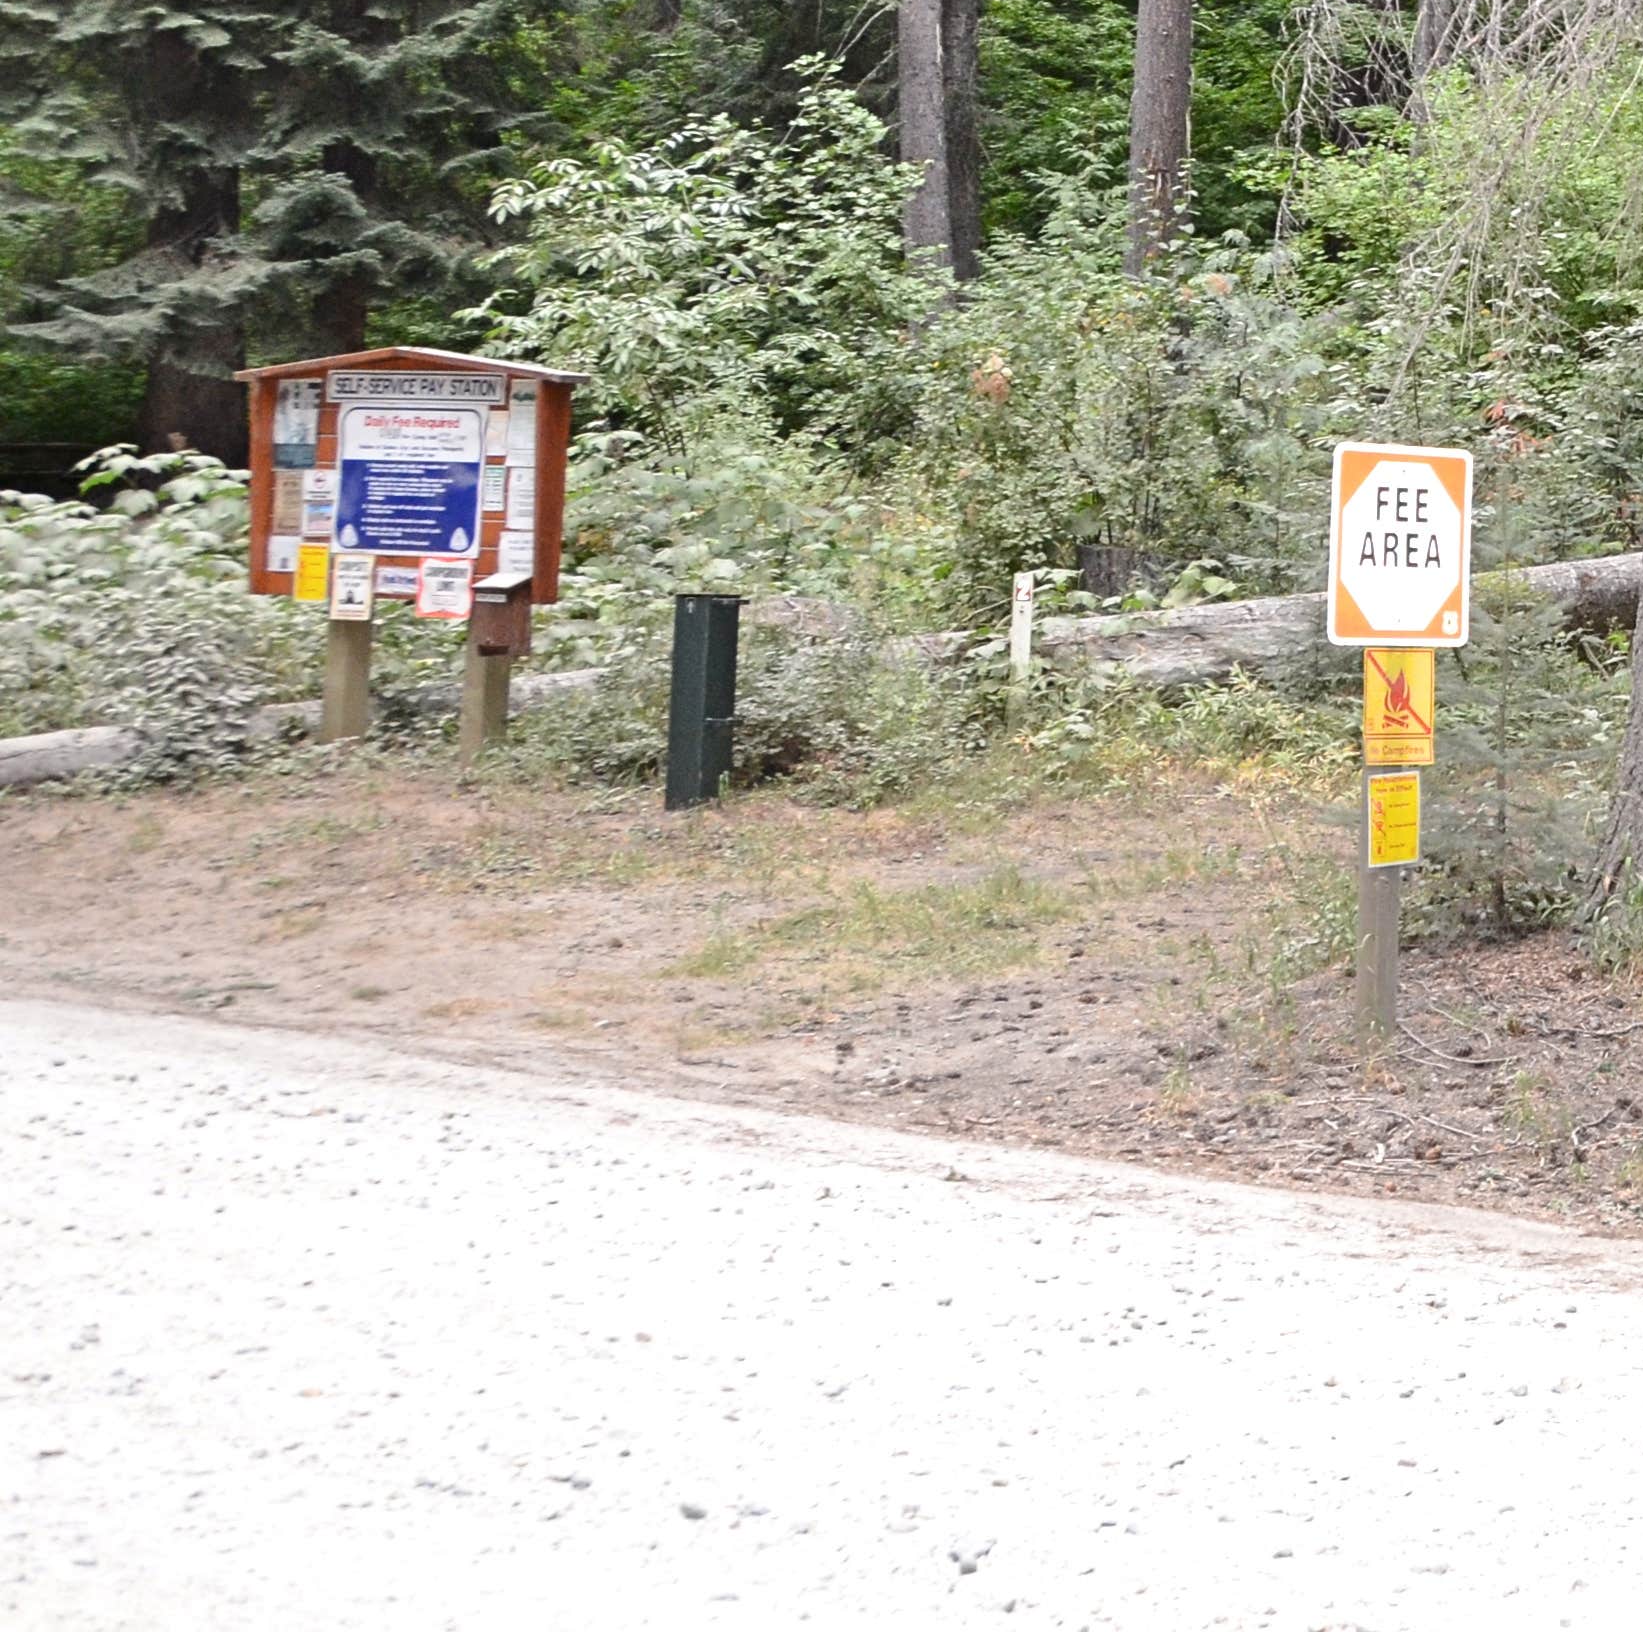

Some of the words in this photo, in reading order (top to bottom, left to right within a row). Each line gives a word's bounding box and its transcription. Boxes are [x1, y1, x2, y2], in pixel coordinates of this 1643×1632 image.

[335, 377, 416, 395] SELF-SERVICE
[420, 379, 445, 396] PAY
[450, 379, 497, 397] STATION
[364, 415, 390, 428] Daily
[392, 416, 411, 428] Fee
[414, 416, 460, 429] Required
[1376, 486, 1429, 523] FEE
[1359, 531, 1441, 569] AREA
[1016, 579, 1031, 601] 2
